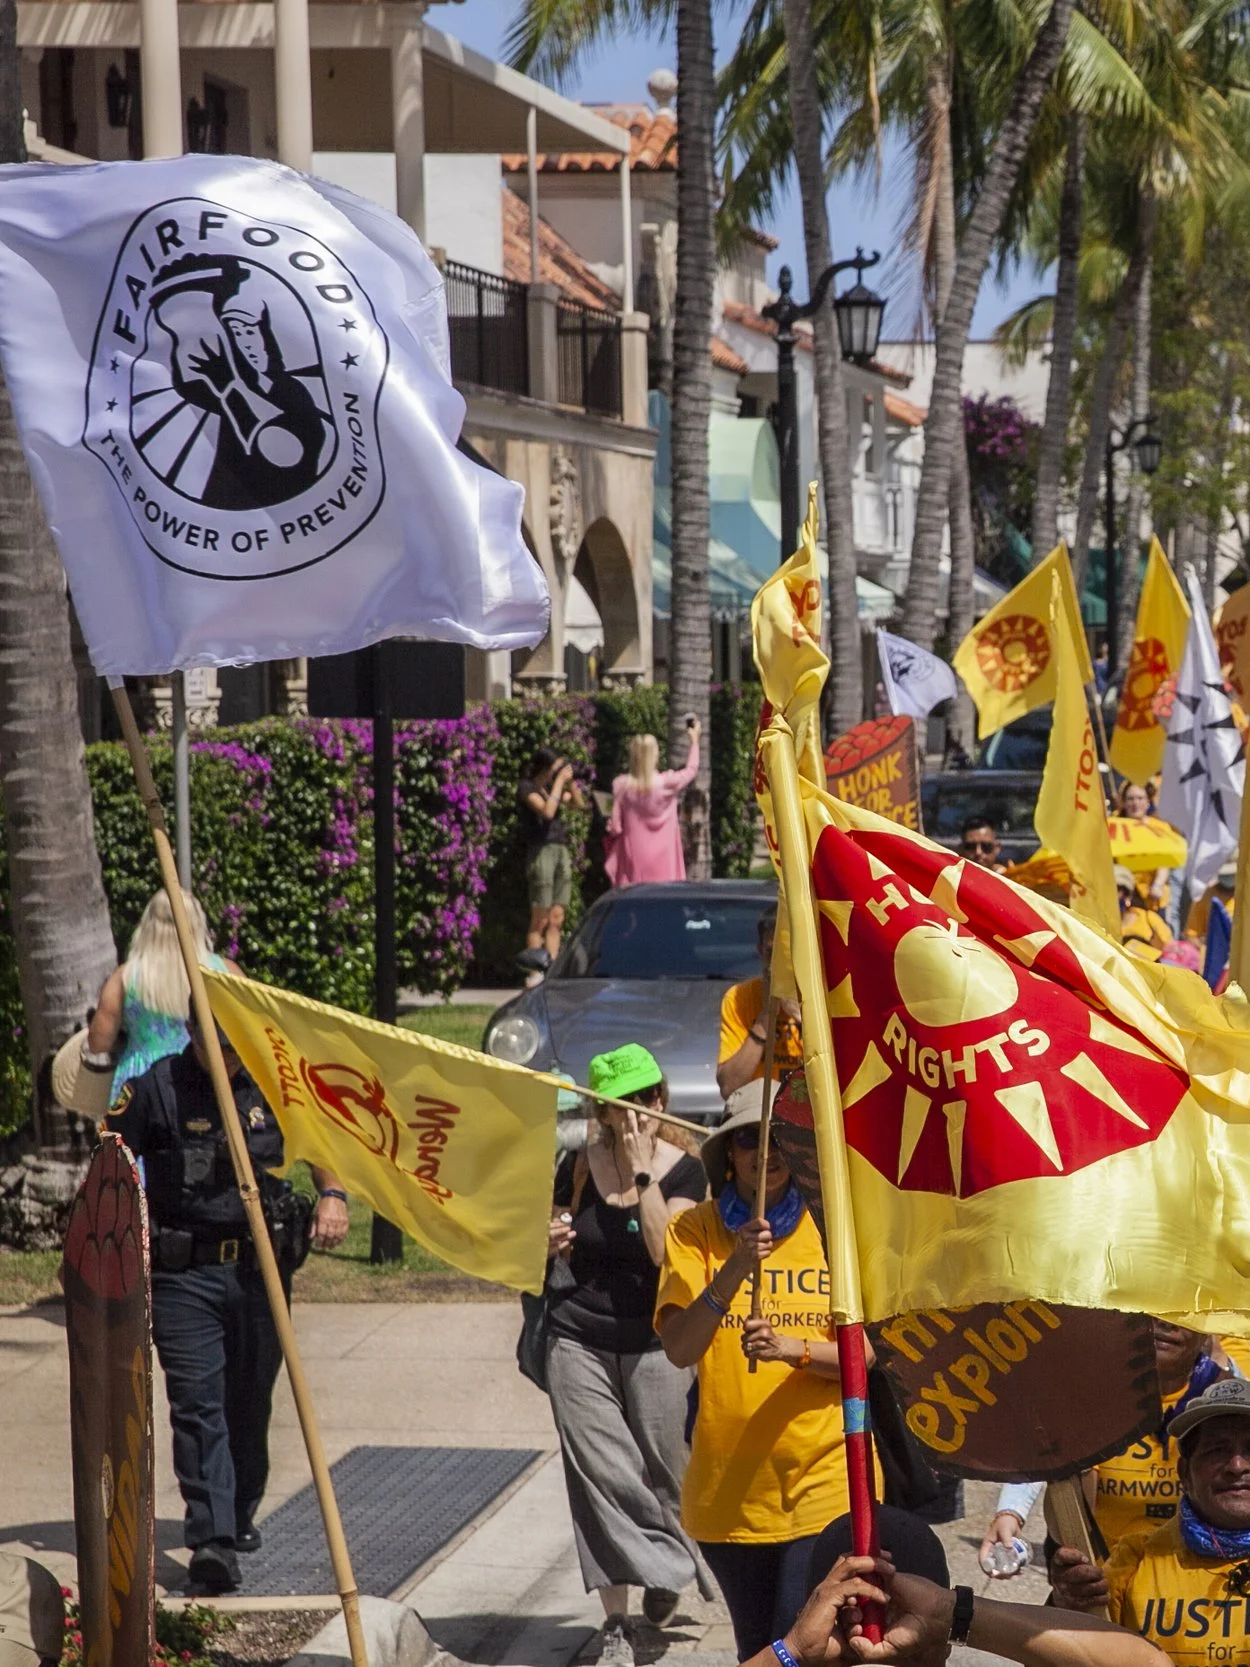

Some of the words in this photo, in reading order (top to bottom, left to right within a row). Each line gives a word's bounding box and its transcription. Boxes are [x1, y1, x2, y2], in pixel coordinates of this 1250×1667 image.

[100, 429, 132, 484] THE
[134, 486, 221, 553] POWER
[232, 529, 270, 553] OF
[281, 392, 368, 545] PREVENTION
[837, 751, 903, 802] HONK
[883, 1011, 1051, 1089] RIGHTS
[762, 1297, 782, 1311] for
[1150, 1463, 1175, 1478] for
[1207, 1641, 1237, 1661] for
